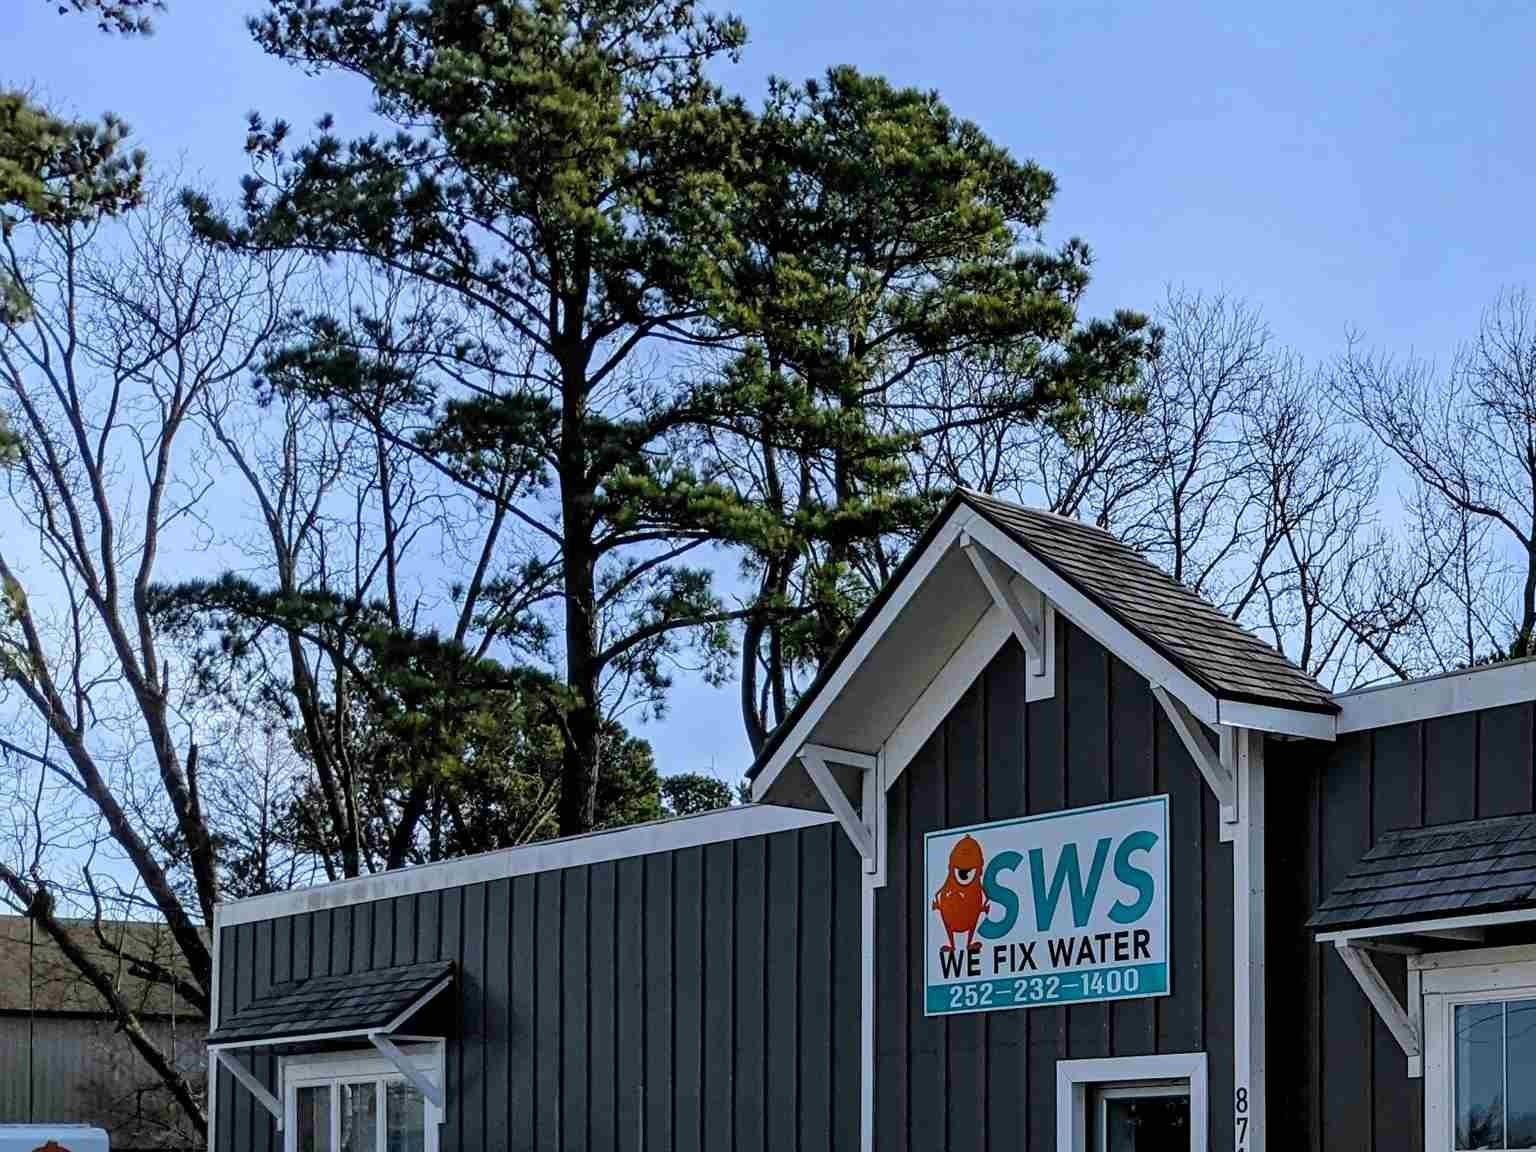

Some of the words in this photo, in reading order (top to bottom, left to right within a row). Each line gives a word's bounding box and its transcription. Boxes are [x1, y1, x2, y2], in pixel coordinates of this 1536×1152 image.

[977, 830, 1159, 940] SWS
[939, 948, 981, 979] WE
[993, 941, 1037, 974] FIX
[1048, 929, 1151, 968] WATER
[950, 968, 1140, 1008] 252-232-1400
